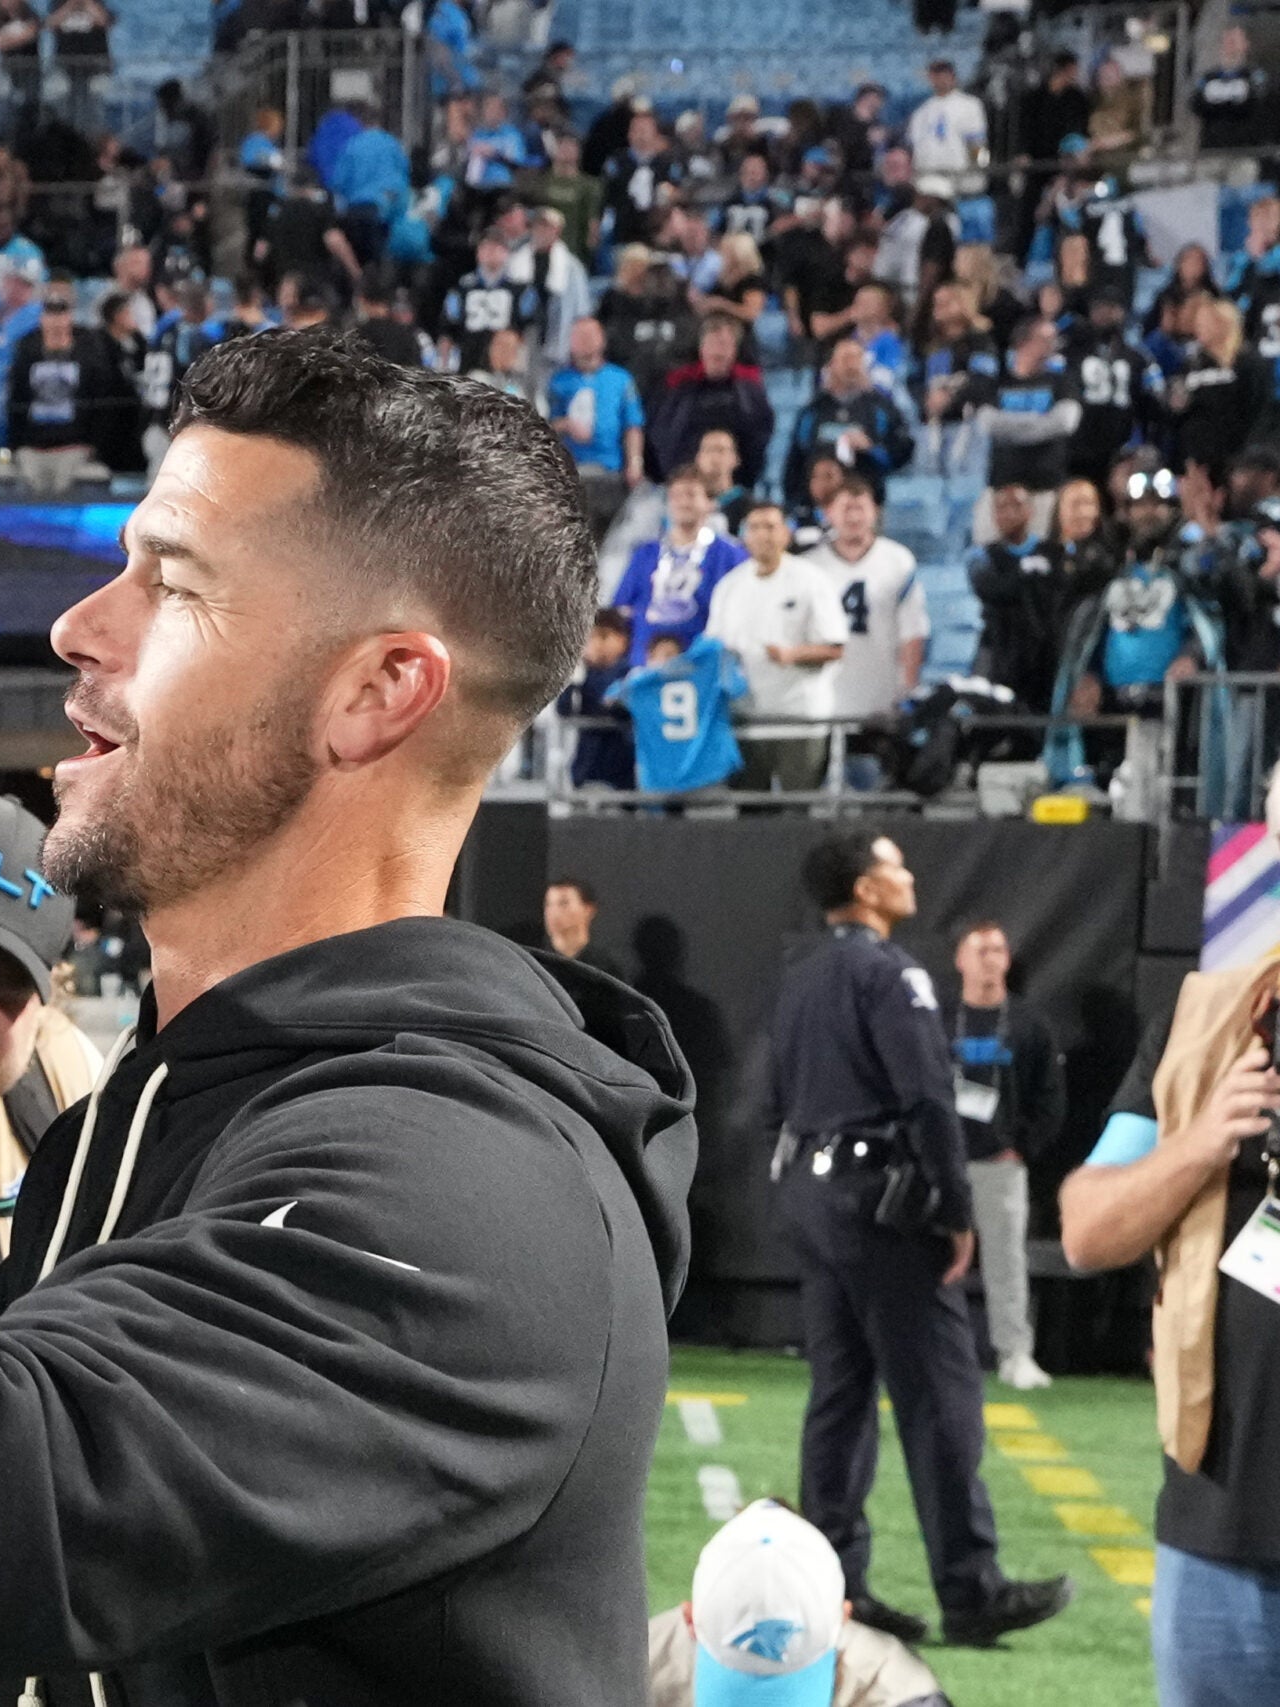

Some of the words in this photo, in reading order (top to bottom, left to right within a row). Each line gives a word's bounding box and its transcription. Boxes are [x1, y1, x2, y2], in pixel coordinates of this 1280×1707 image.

[1081, 355, 1131, 408] 91
[841, 580, 868, 634] 4
[659, 680, 698, 742] 9
